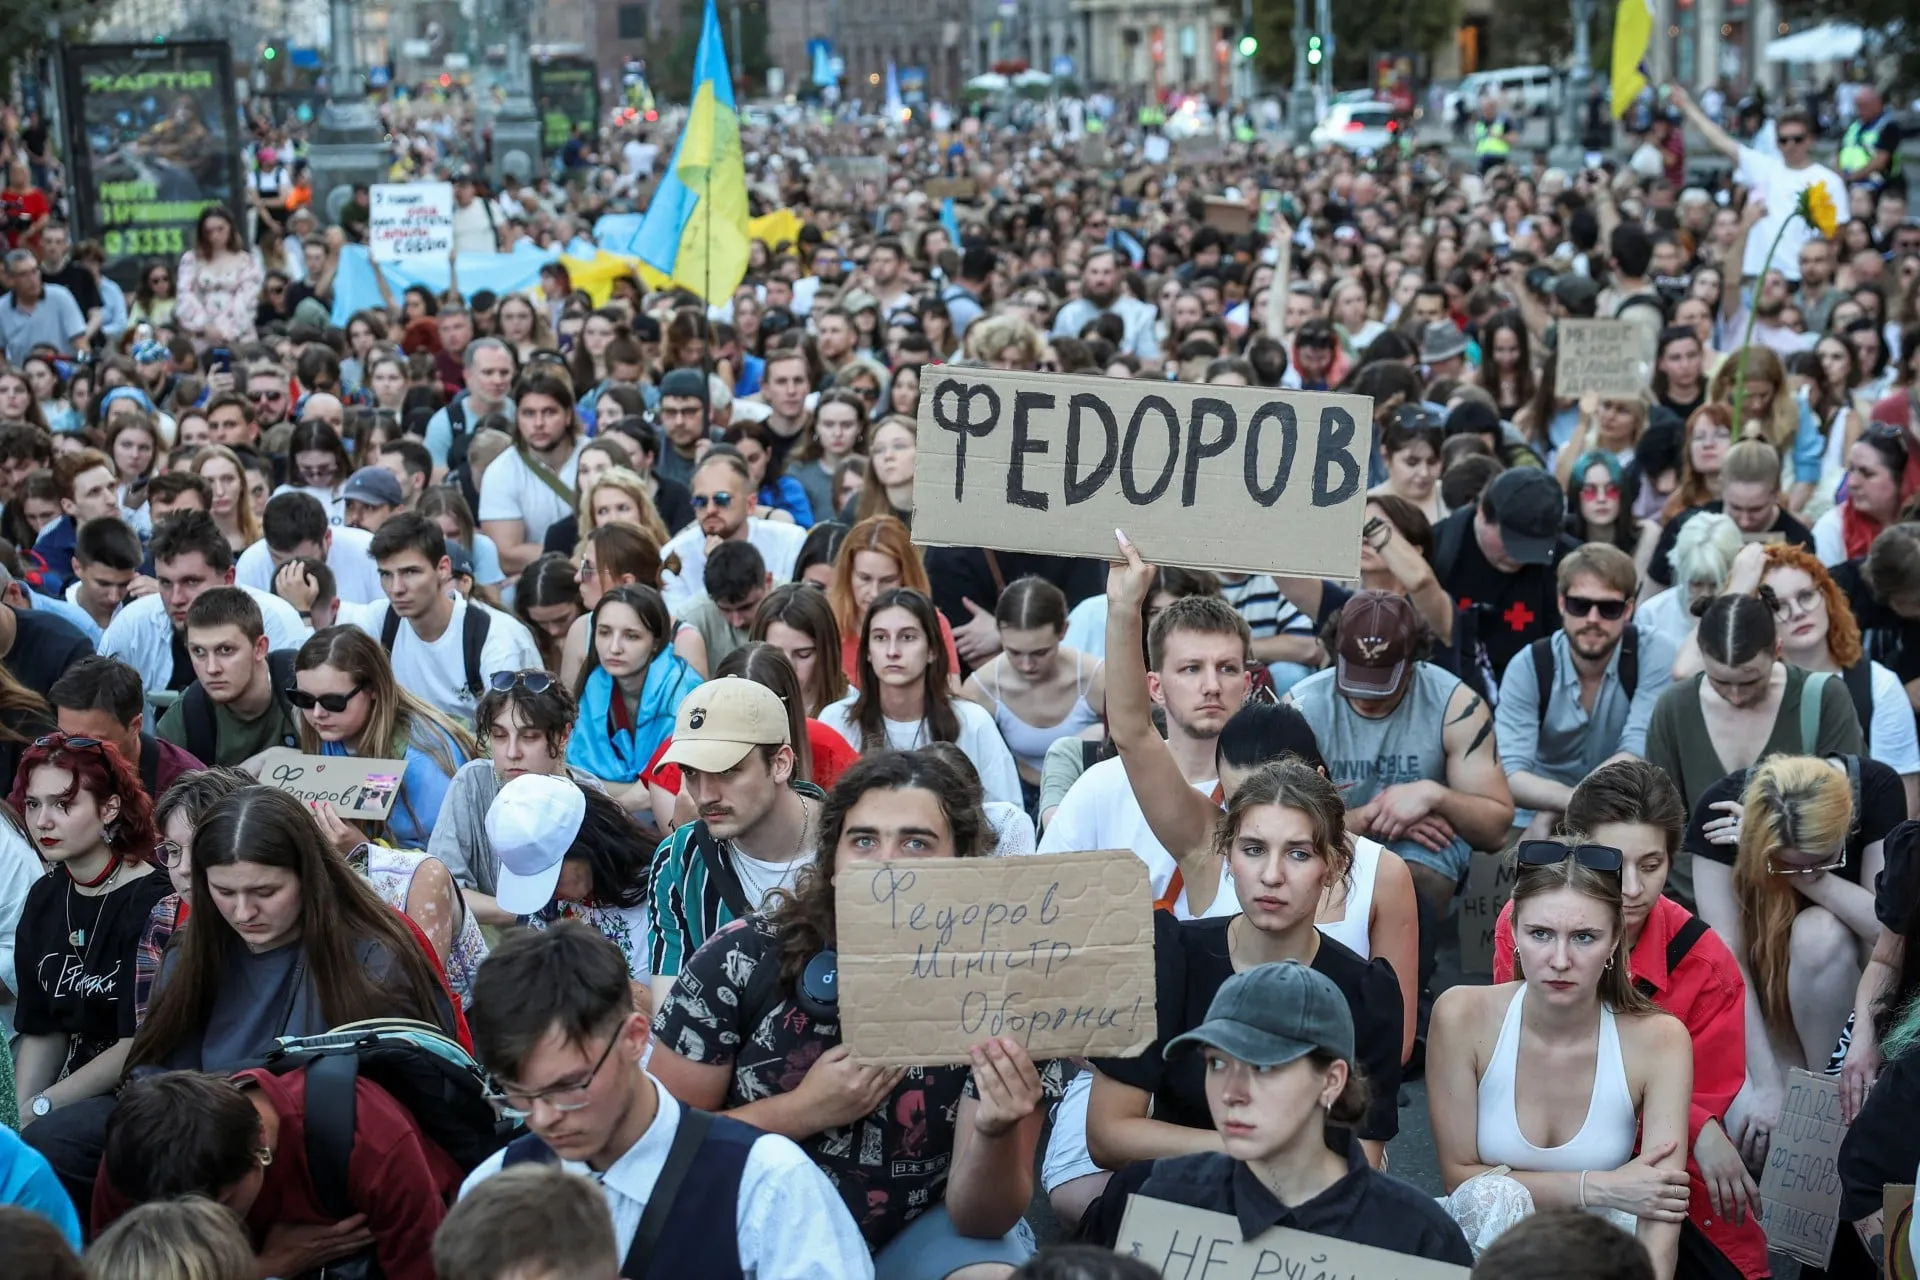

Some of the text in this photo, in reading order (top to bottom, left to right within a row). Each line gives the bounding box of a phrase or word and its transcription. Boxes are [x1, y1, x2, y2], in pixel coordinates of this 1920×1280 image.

[932, 377, 1360, 511] ФЕДОРОВ
[1328, 754, 1420, 780] INVINCBLE
[871, 863, 1060, 946] Федоров
[910, 937, 1071, 979] Міністр
[961, 990, 1142, 1048] Оборони!
